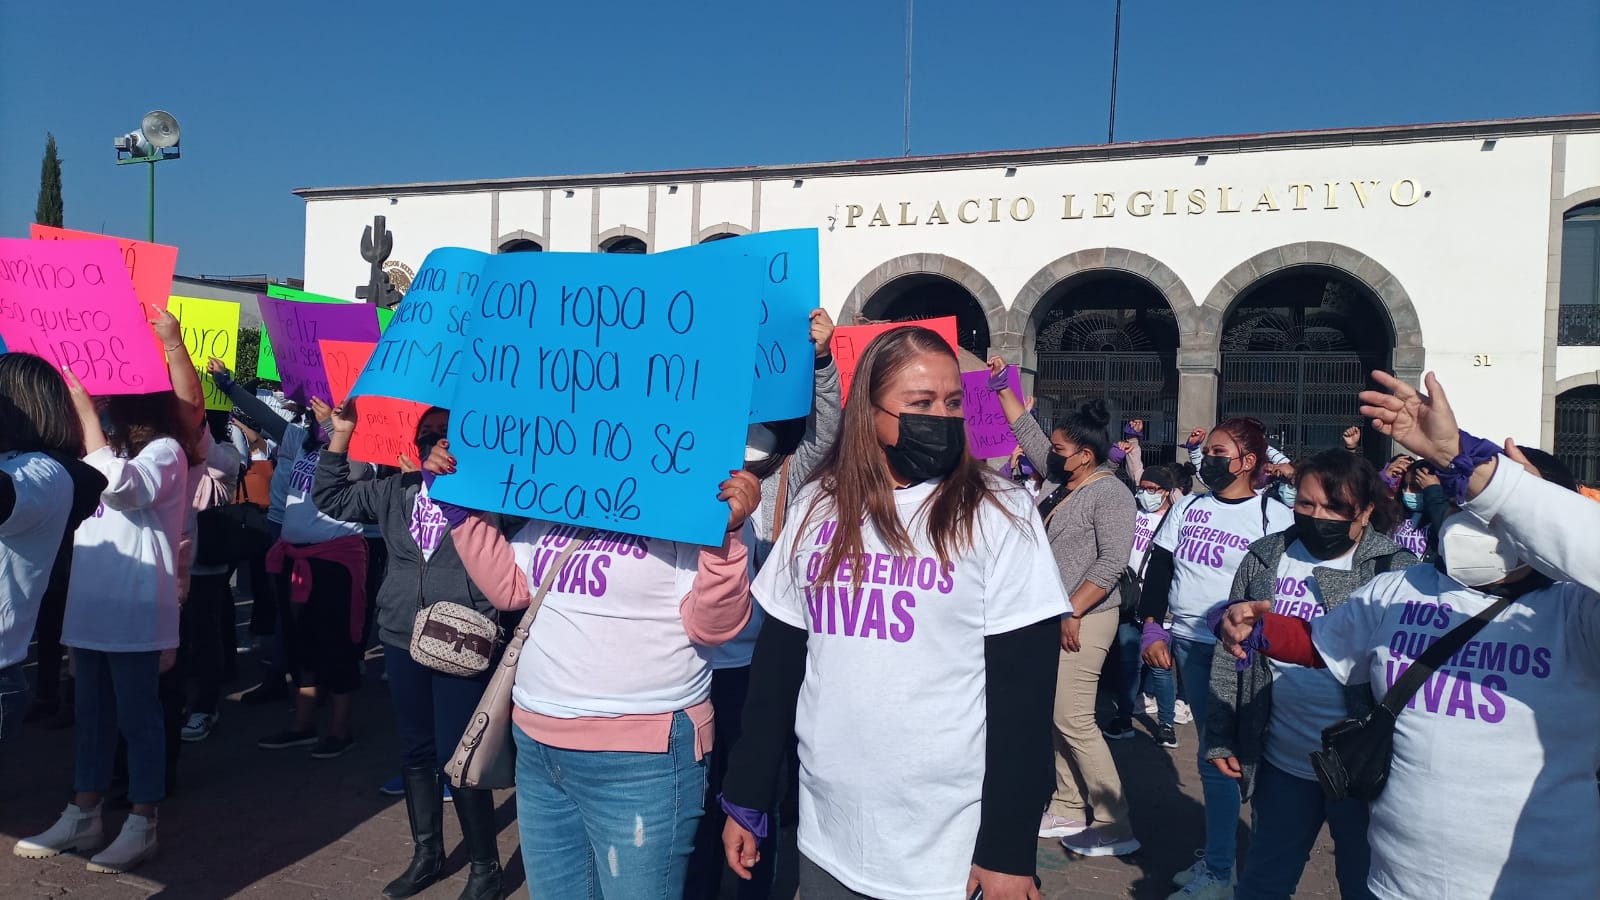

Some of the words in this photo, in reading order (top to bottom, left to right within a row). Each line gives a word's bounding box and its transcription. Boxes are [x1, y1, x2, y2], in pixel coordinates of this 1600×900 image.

[845, 197, 1036, 229] PALACIO
[1061, 179, 1422, 220] LEGISLATIVO
[30, 307, 111, 337] quiero
[481, 279, 537, 329] con
[560, 284, 646, 348] ropa
[667, 289, 694, 335] o
[1473, 354, 1492, 367] 31
[538, 346, 620, 413] ropa
[460, 410, 577, 474] cuerpo
[592, 419, 632, 462] no
[1185, 508, 1213, 524] NOS
[1173, 538, 1226, 568] VIVAS
[1180, 525, 1250, 551] QUEREMOS
[804, 585, 916, 643] VIVAS
[1400, 600, 1453, 630] NOS
